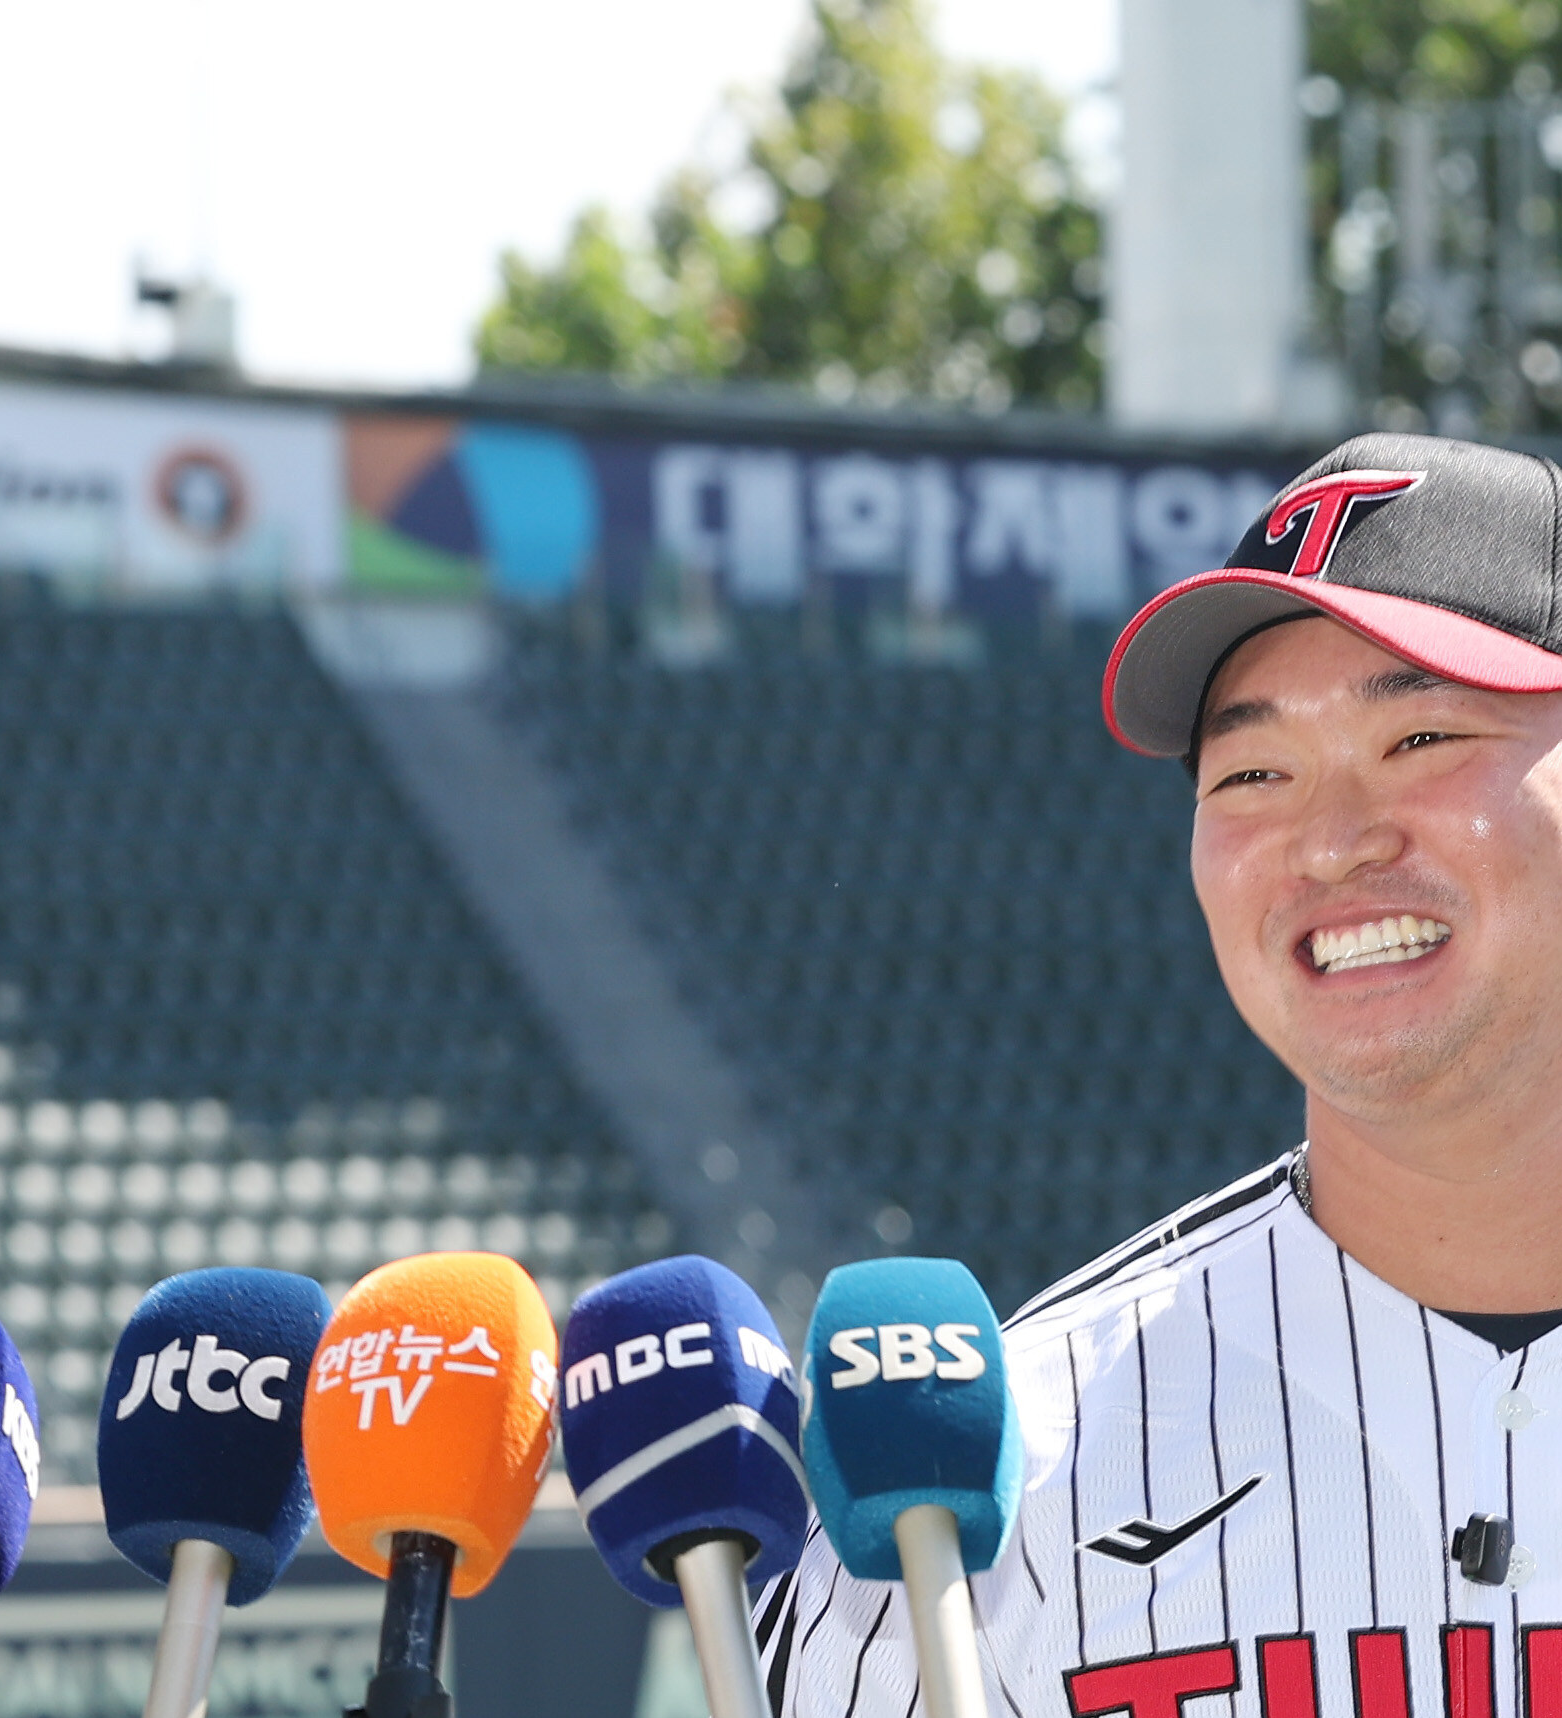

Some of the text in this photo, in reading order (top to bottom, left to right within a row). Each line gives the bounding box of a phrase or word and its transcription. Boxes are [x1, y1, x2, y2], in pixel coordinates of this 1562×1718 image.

[315, 1323, 501, 1394] 연합뉴스
[829, 1322, 987, 1391] SBS
[349, 1374, 434, 1431] TV
